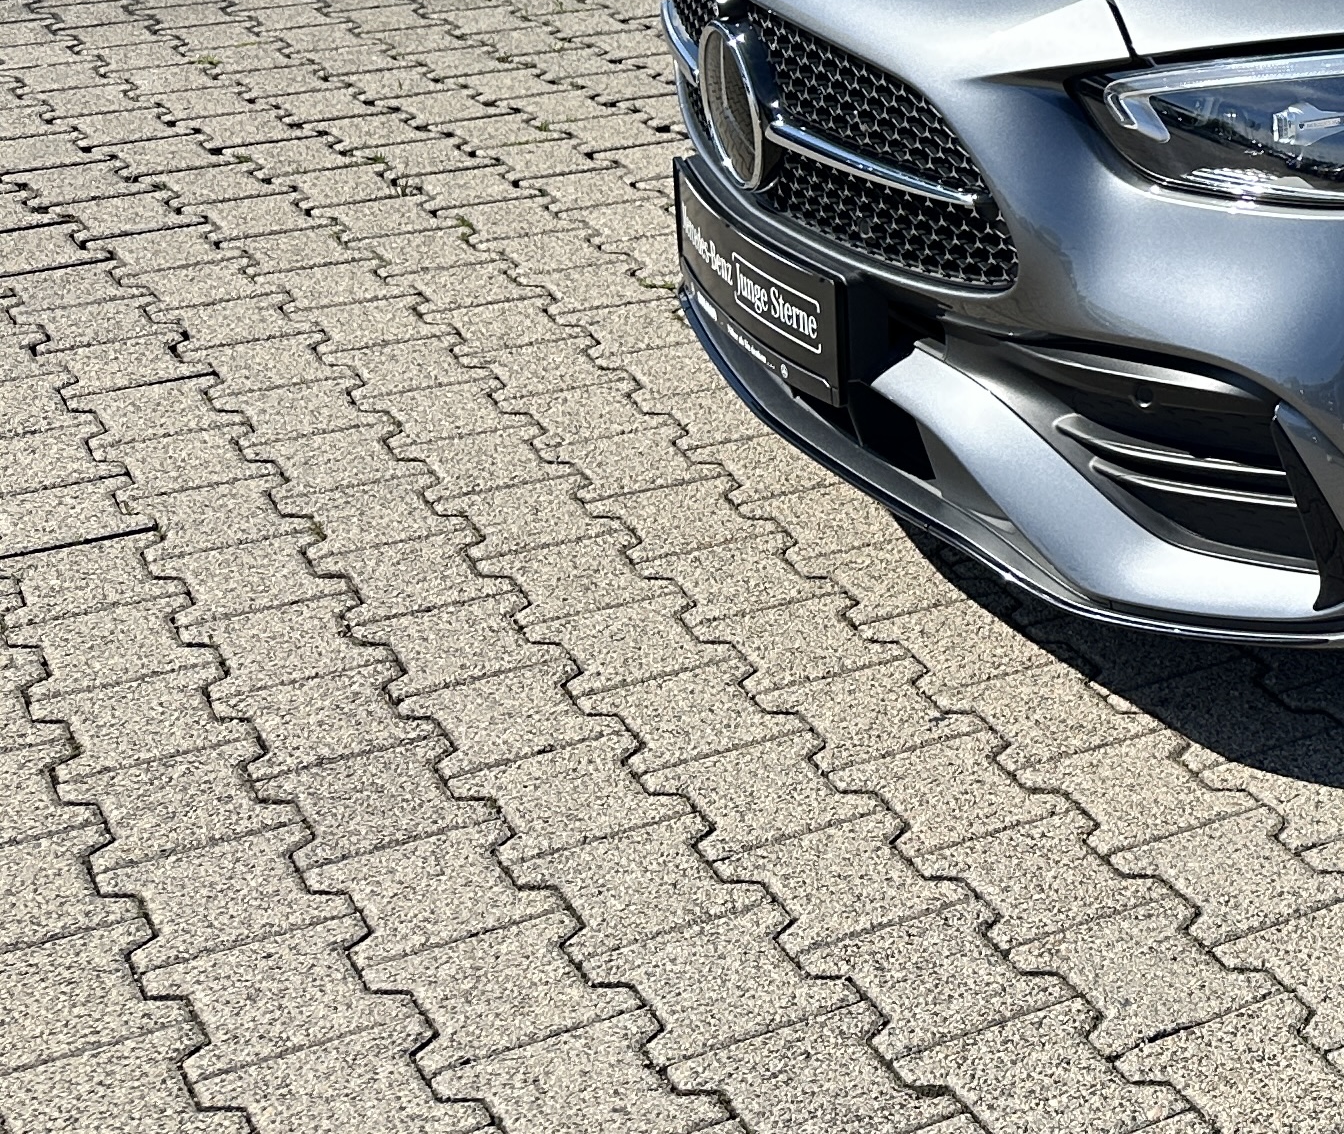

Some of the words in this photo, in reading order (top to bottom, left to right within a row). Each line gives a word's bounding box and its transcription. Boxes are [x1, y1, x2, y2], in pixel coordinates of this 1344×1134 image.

[681, 202, 734, 287] Mercedes-Benz
[735, 262, 769, 314] Junge
[770, 286, 818, 340] Sterne
